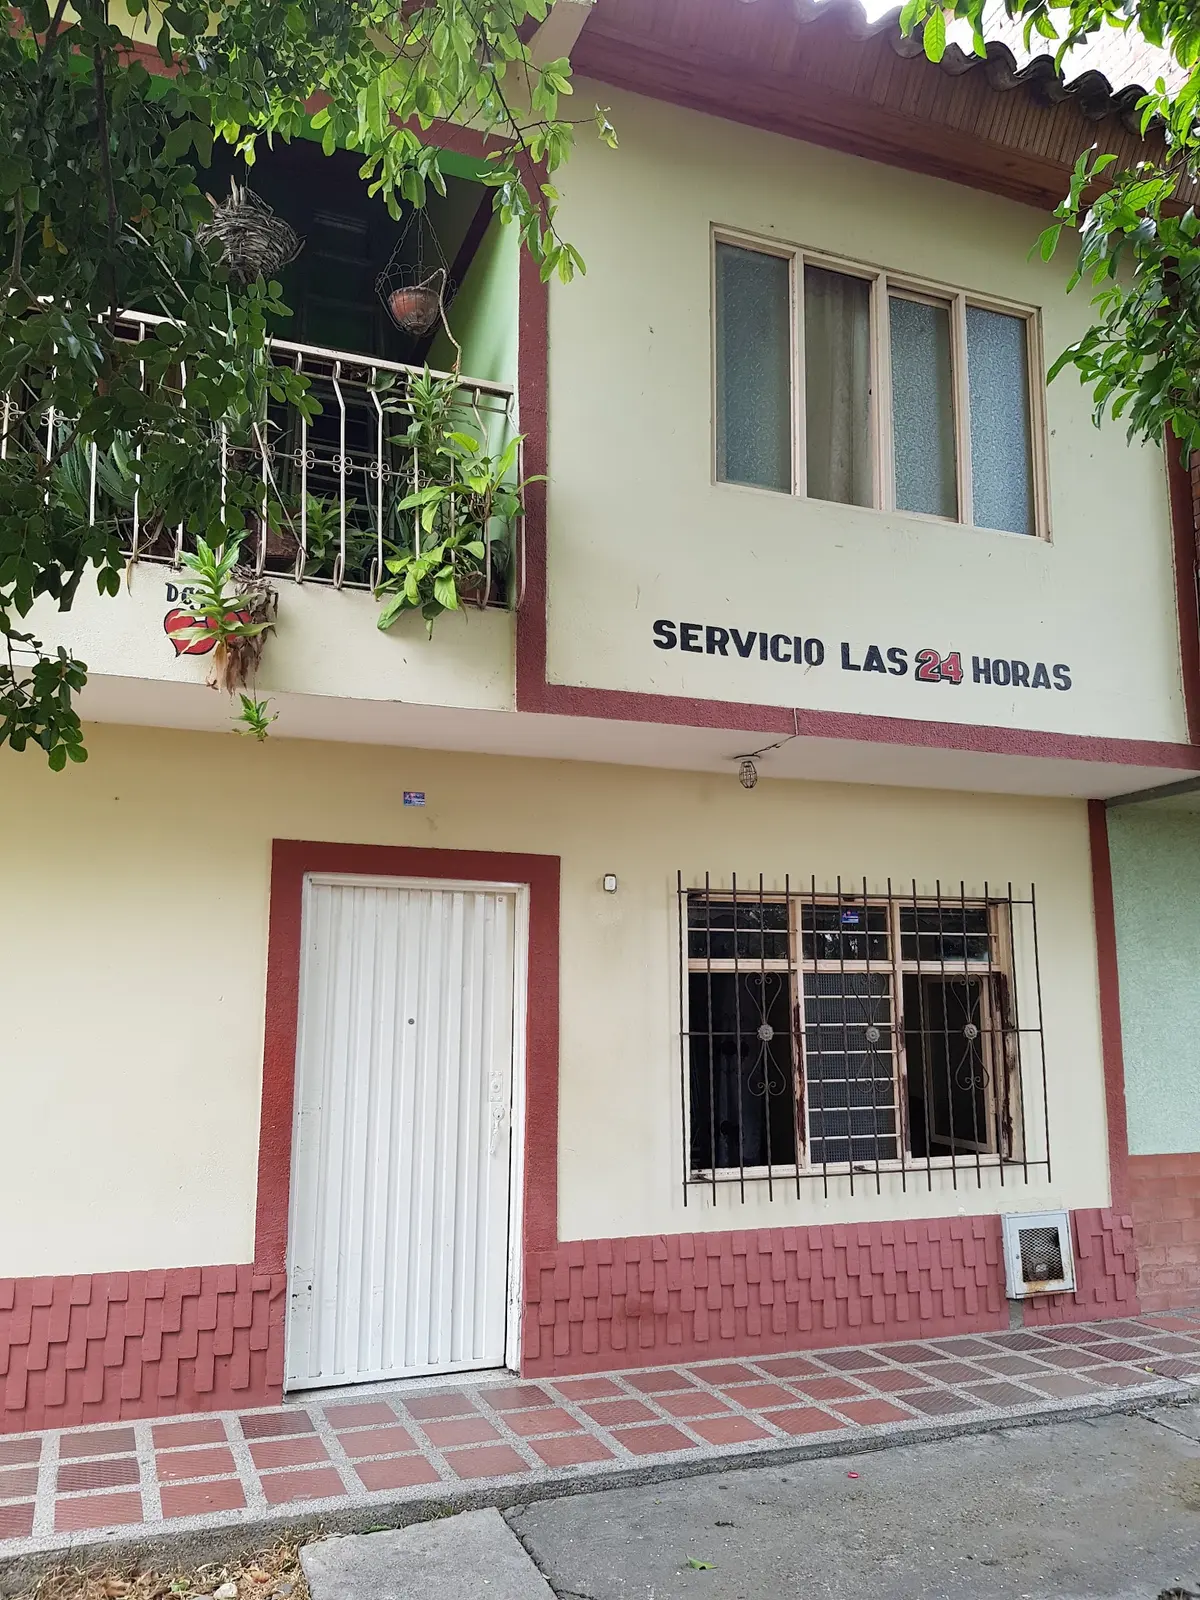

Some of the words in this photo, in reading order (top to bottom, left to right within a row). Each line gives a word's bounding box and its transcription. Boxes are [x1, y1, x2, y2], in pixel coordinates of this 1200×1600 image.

[652, 619, 825, 667] SERVICIO
[840, 642, 908, 676] LAS
[914, 648, 964, 685] 24
[972, 655, 1072, 691] HORAS
